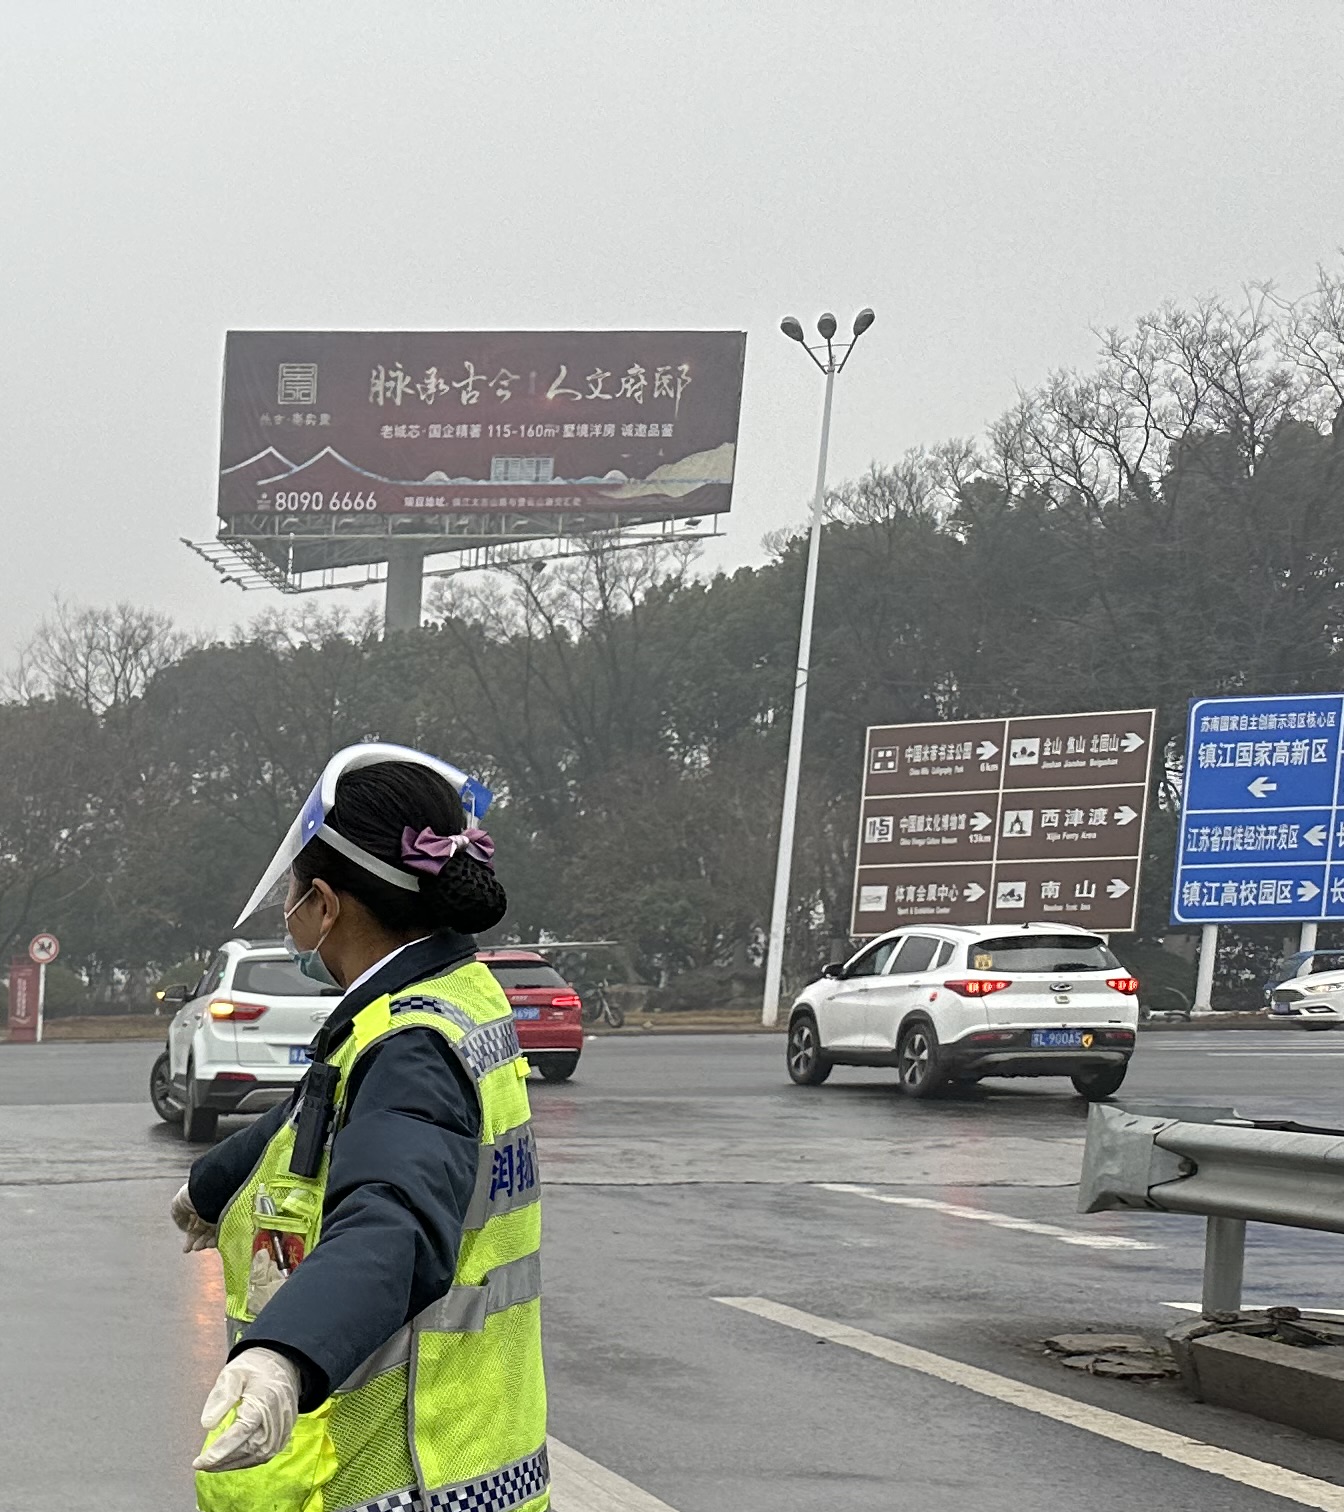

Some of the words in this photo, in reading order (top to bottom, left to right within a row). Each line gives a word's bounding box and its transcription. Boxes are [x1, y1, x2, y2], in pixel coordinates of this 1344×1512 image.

[546, 363, 693, 418] 人文府邸
[274, 491, 324, 511] 8090
[329, 491, 377, 510] 6666
[1043, 737, 1062, 756] 金山
[1197, 738, 1329, 769] 镇江国家高新区
[1040, 808, 1109, 828] 西津渡
[1186, 823, 1301, 853] 江苏省丹徒经济开发区
[895, 884, 959, 903] 体育会展中心
[1182, 879, 1294, 907] 镇江高校园区
